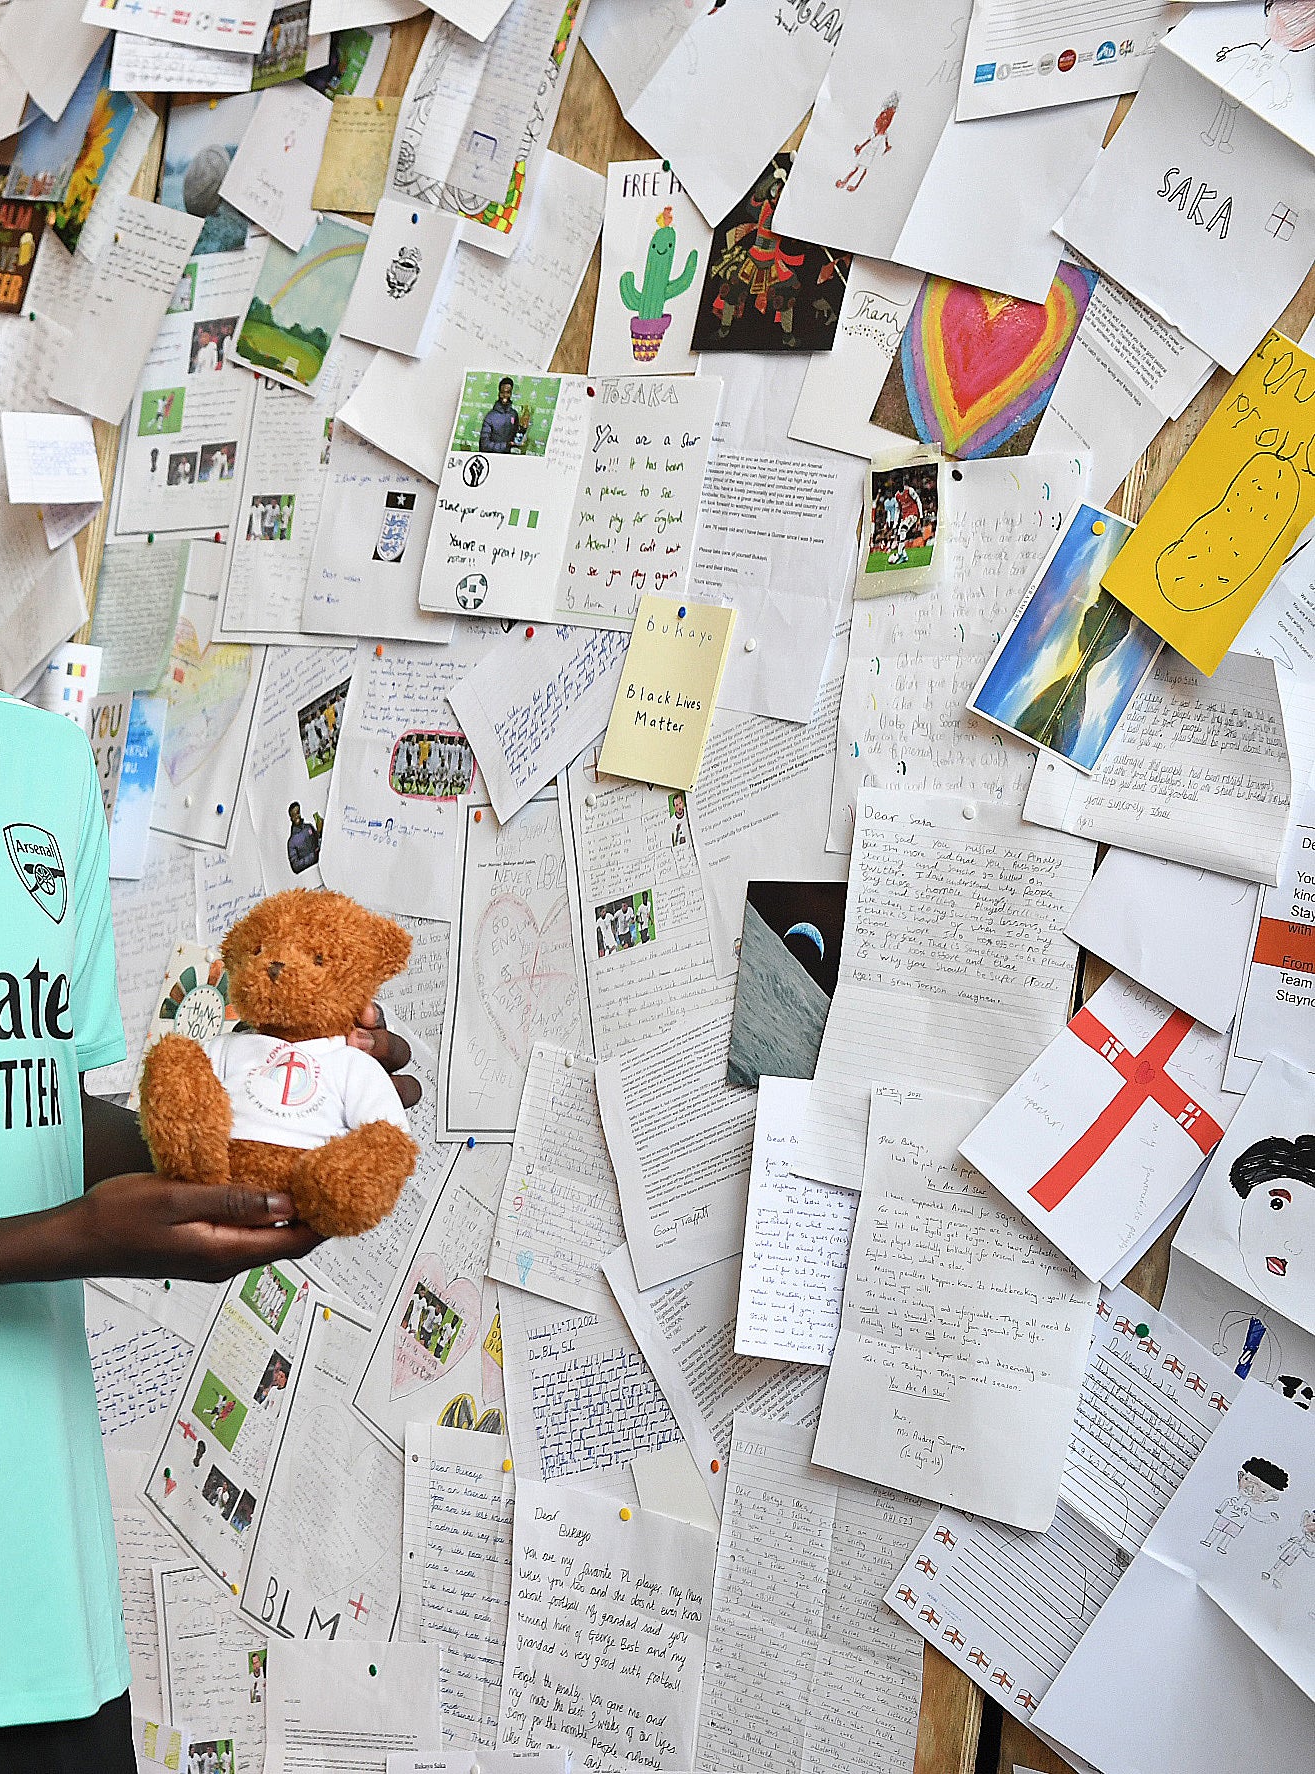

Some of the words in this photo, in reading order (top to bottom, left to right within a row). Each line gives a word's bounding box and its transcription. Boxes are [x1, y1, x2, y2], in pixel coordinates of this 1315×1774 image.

[623, 172, 660, 197] FREE
[1157, 167, 1235, 240] SAKA
[620, 382, 679, 407] SAKA
[663, 435, 671, 446] a
[645, 456, 657, 471] has
[665, 458, 684, 472] been
[585, 486, 591, 495] a
[640, 485, 649, 497] to
[660, 488, 673, 499] see
[580, 511, 595, 527] you
[633, 513, 648, 529] for
[626, 537, 629, 552] I
[569, 562, 575, 575] to
[586, 567, 599, 577] see
[630, 570, 646, 590] play
[645, 614, 714, 643] Bukayo
[1278, 621, 1288, 632] Come
[625, 683, 672, 707] Black
[674, 695, 702, 712] Lives
[91, 703, 123, 740] YOU
[633, 709, 685, 734] Matter
[864, 804, 899, 822] Dear
[14, 838, 55, 859] Arsenal
[494, 869, 532, 884] NEVER
[1288, 924, 1312, 936] with
[1282, 955, 1314, 971] From
[1280, 972, 1312, 989] Team
[1122, 982, 1167, 1020] BUKAYO
[186, 1002, 219, 1027] THANK
[187, 1021, 208, 1039] YOU
[878, 1136, 895, 1145] Dear
[942, 1179, 955, 1191] Are
[962, 1183, 969, 1194] A
[1018, 1232, 1040, 1242] credit
[1039, 1262, 1079, 1280] especially
[1025, 1318, 1037, 1328] all
[1040, 1322, 1059, 1332] need
[1064, 1323, 1071, 1332] to
[905, 1382, 918, 1393] Are
[921, 1386, 928, 1395] A
[912, 1431, 936, 1452] Audrey
[430, 1460, 450, 1475] Dear
[534, 1507, 560, 1522] Dear
[559, 1524, 592, 1546] Bukayo
[523, 1546, 540, 1563] You
[560, 1557, 575, 1574] my
[620, 1569, 632, 1584] PL
[668, 1585, 685, 1607] My
[547, 1576, 564, 1595] you
[590, 1585, 608, 1599] and
[518, 1588, 543, 1605] about
[600, 1609, 637, 1633] grandad
[644, 1622, 663, 1637] said
[668, 1630, 689, 1647] you
[516, 1634, 556, 1657] grandad
[560, 1643, 570, 1659] is
[593, 1655, 615, 1672] good
[552, 1617, 572, 1633] him
[574, 1626, 583, 1641] of
[588, 1628, 617, 1650] George
[620, 1639, 641, 1654] Best
[648, 1646, 667, 1660] and
[669, 1653, 688, 1673] my
[542, 1674, 553, 1688] the
[629, 1707, 641, 1720] me
[646, 1712, 668, 1727] and
